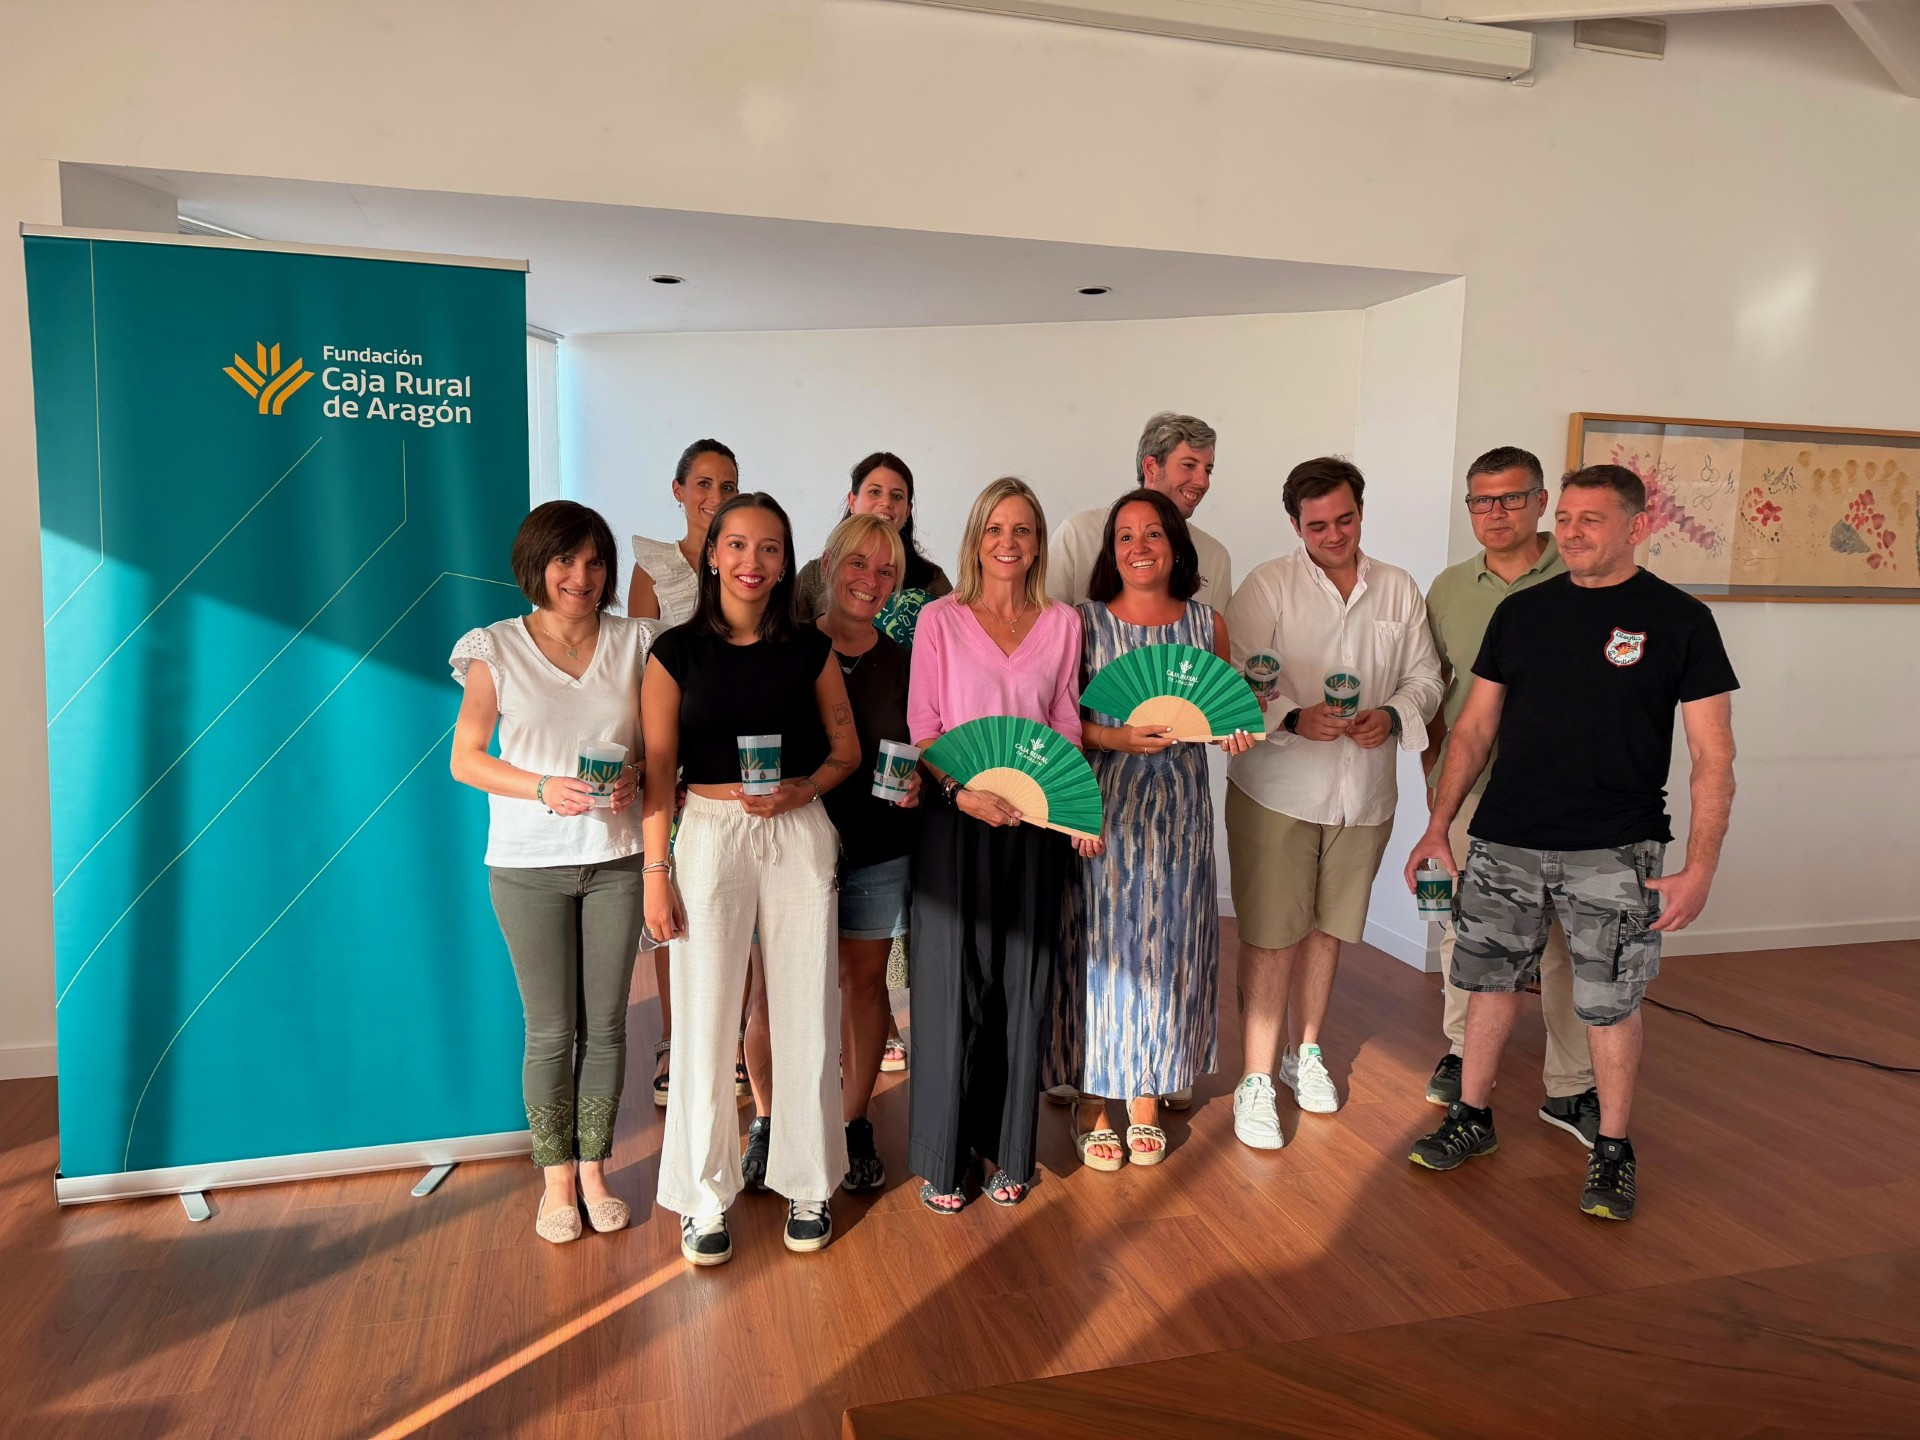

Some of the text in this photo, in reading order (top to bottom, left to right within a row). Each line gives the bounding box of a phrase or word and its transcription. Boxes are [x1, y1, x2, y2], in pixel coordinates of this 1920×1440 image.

[323, 345, 423, 366] Fundación
[322, 366, 471, 398] Caja Rural
[322, 394, 472, 428] de Aragón
[1014, 742, 1048, 765] CAJA RURAL
